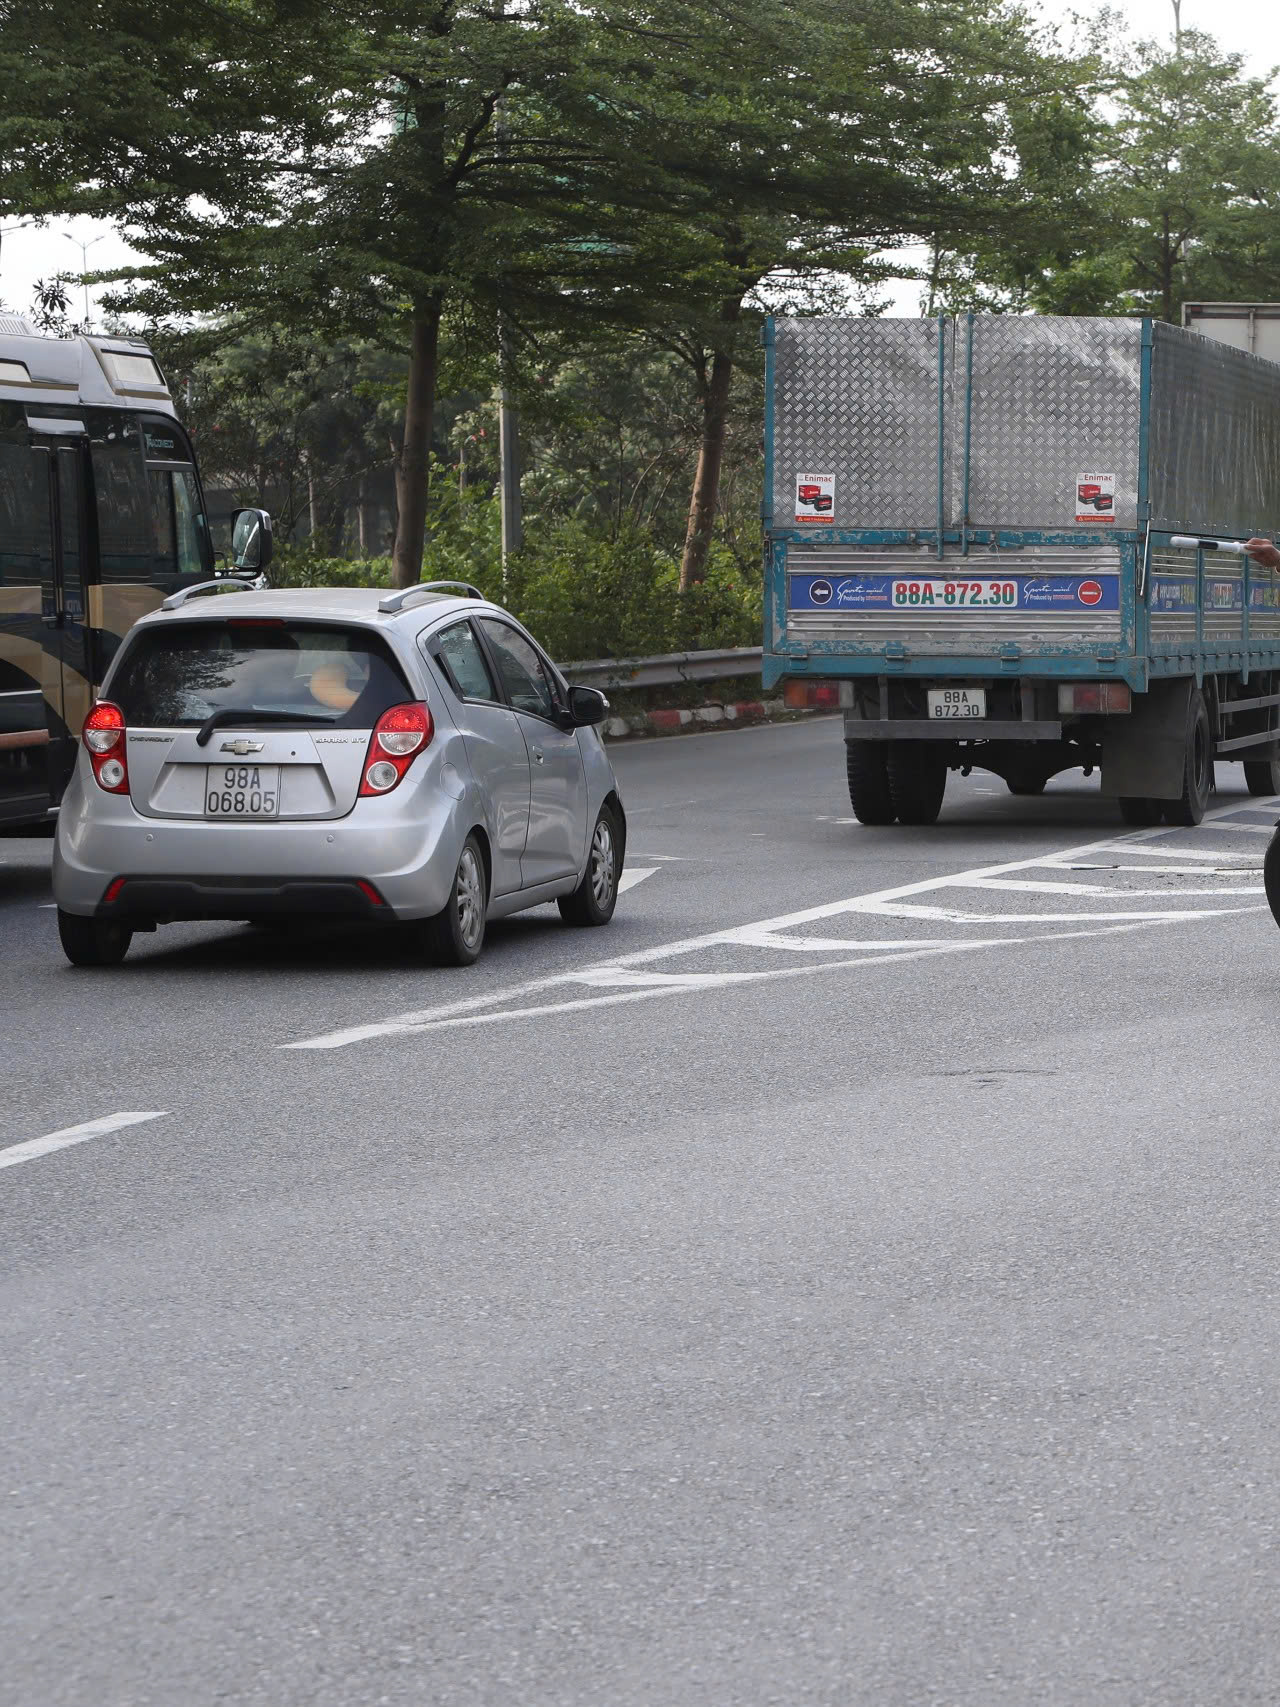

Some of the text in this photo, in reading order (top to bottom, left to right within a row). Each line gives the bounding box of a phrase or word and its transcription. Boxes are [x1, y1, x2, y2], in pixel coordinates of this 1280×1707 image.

[804, 474, 833, 482] Enimac
[1084, 473, 1113, 481] Enimac
[895, 583, 1015, 605] 88A-872.30
[944, 691, 969, 703] 88A
[935, 704, 980, 717] 872.30
[224, 767, 261, 789] 98A
[207, 791, 276, 813] 068.05
